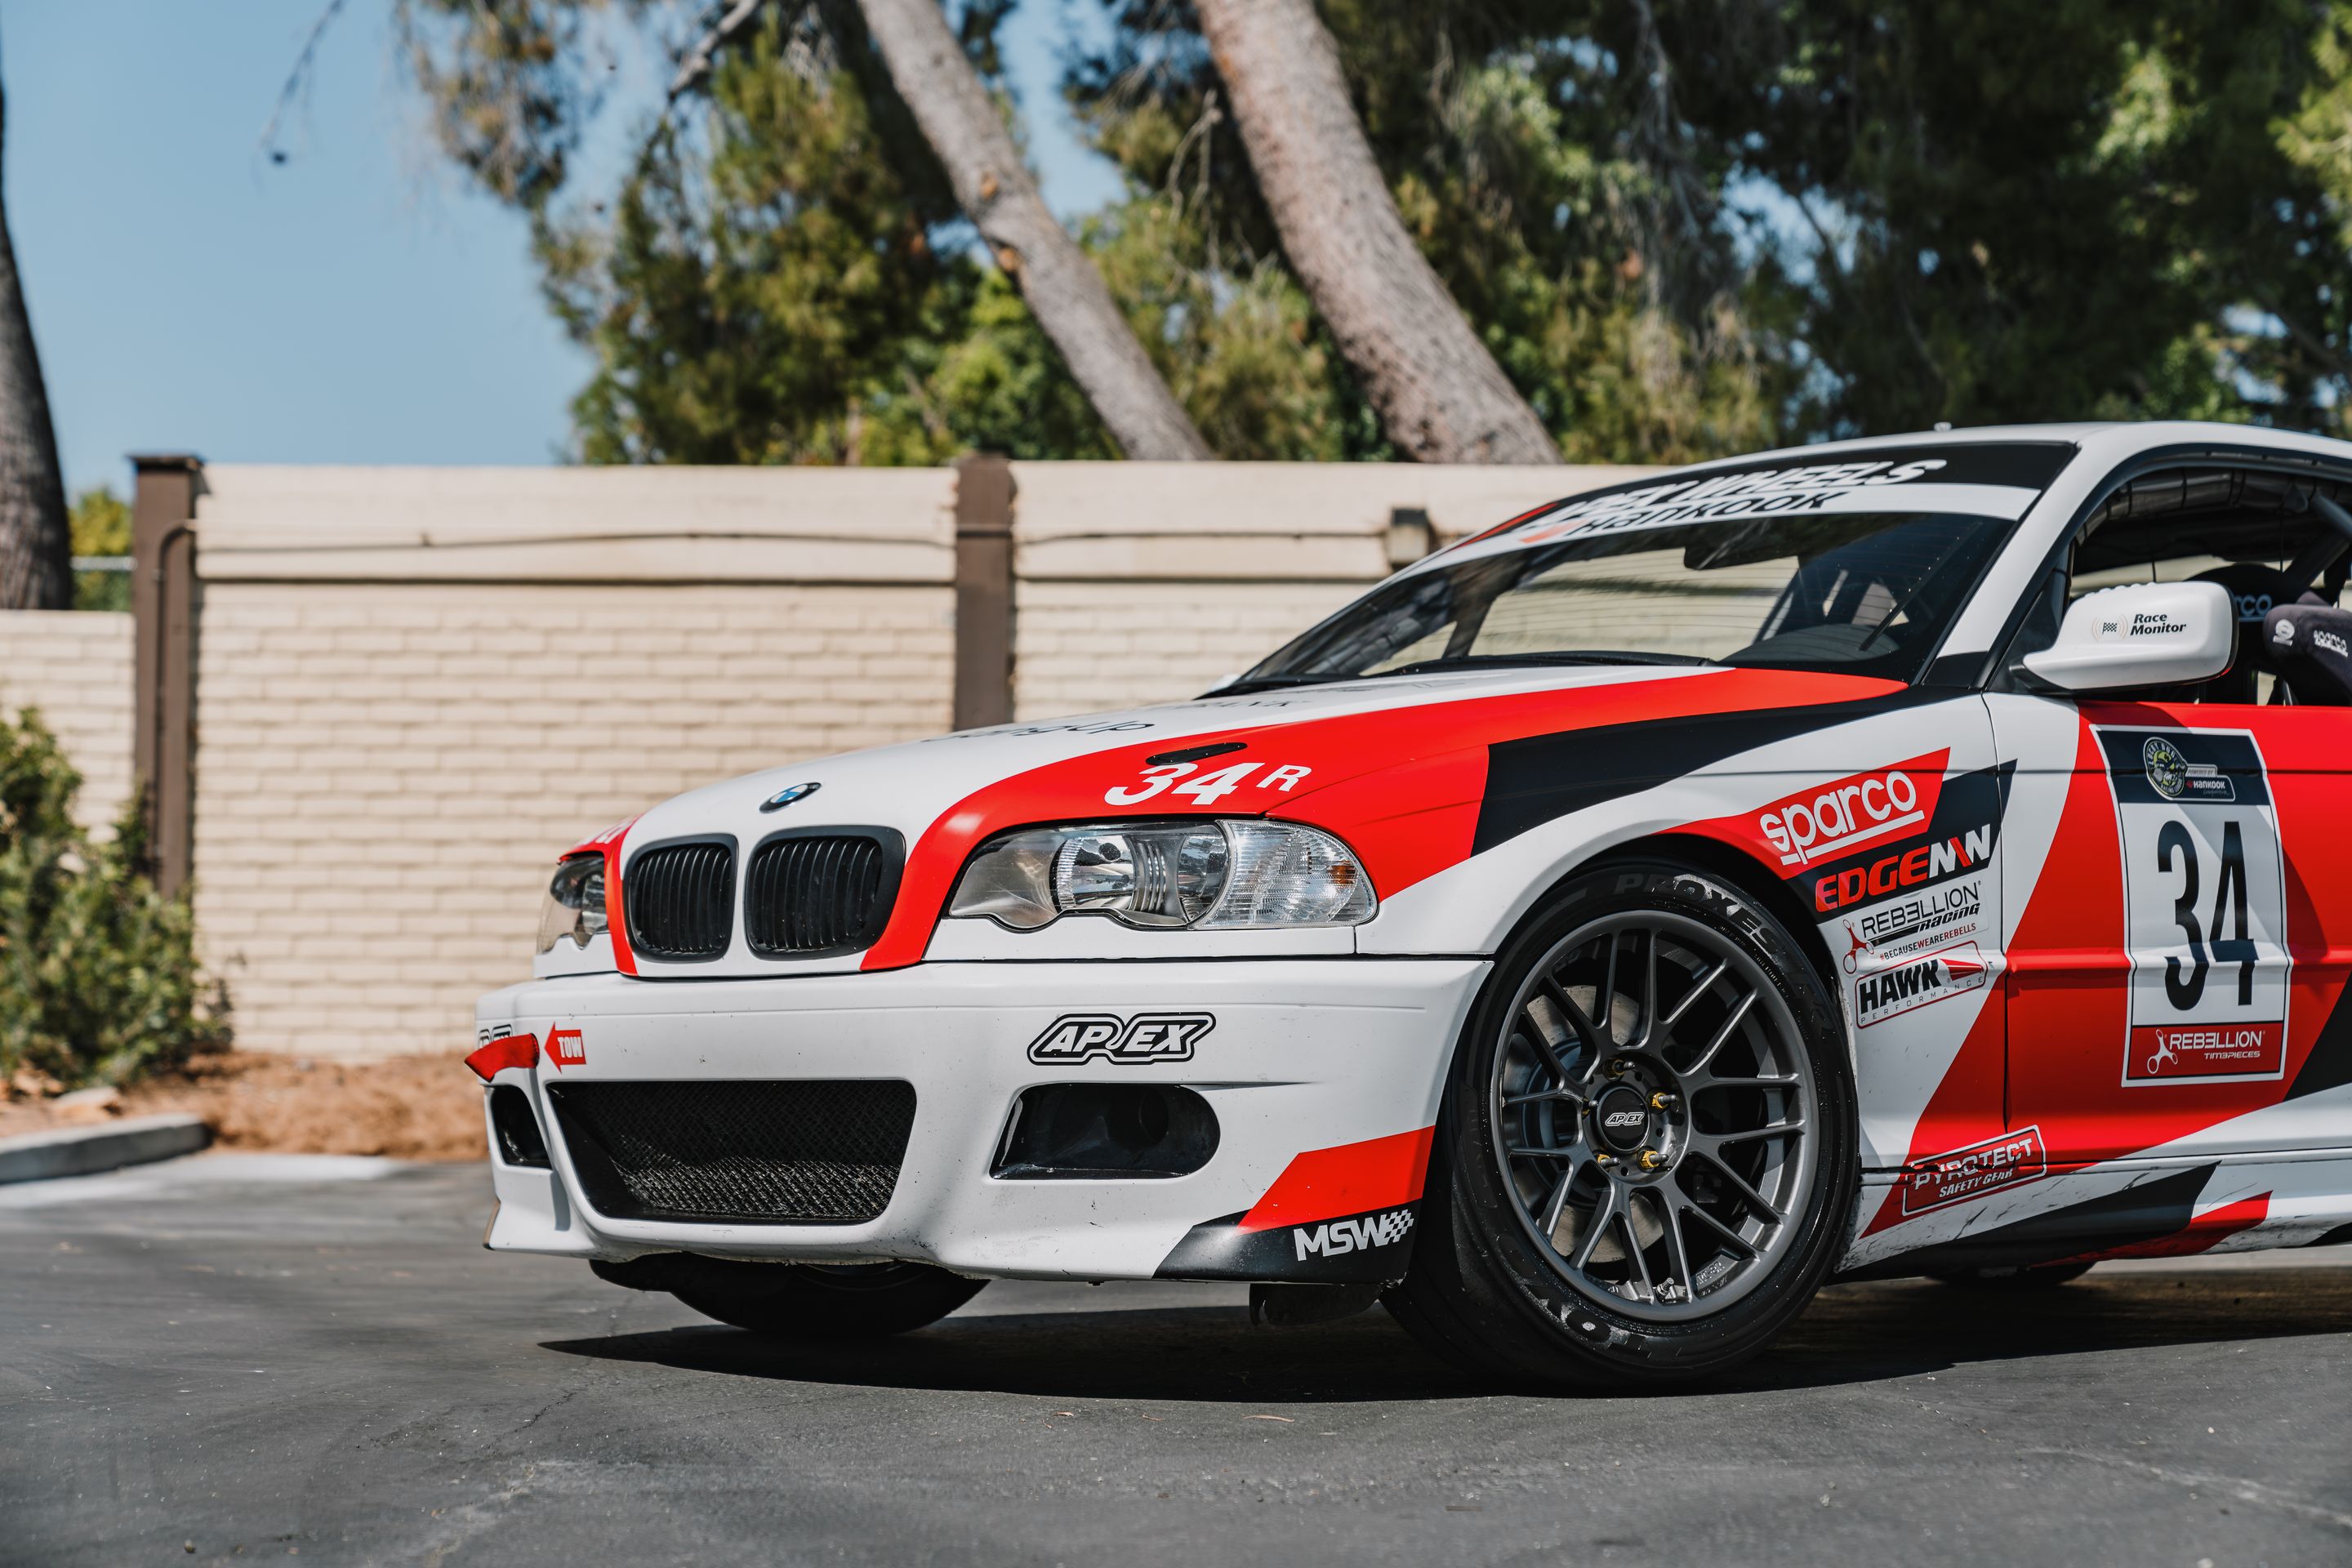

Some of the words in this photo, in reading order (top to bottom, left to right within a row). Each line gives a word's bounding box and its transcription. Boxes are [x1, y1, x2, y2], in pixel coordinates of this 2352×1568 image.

[1667, 459, 1947, 502] WHEELS
[2130, 622, 2187, 636] Monitor
[2133, 613, 2167, 625] Race
[1103, 762, 1265, 806] 34
[1256, 764, 1312, 792] R
[1760, 770, 1917, 866] sparco
[1612, 872, 1780, 956] PROXES
[1860, 881, 1979, 938] REBELLION
[2157, 820, 2260, 1011] 34
[1879, 922, 1976, 960] #BECAUSEWEAREREBELLS
[1859, 959, 1942, 1014] HAWK
[1860, 976, 1983, 1024] PERFORMANCE
[557, 1036, 583, 1058] TOW
[1034, 1018, 1209, 1059] APEX
[2169, 1030, 2262, 1050] REBELLION
[1606, 1114, 1642, 1125] APEX
[1914, 1138, 2033, 1191] PYROTECT
[1939, 1176, 1982, 1198] SAFETY
[1982, 1168, 2013, 1185] GEAR
[1294, 1214, 1388, 1262] MSW
